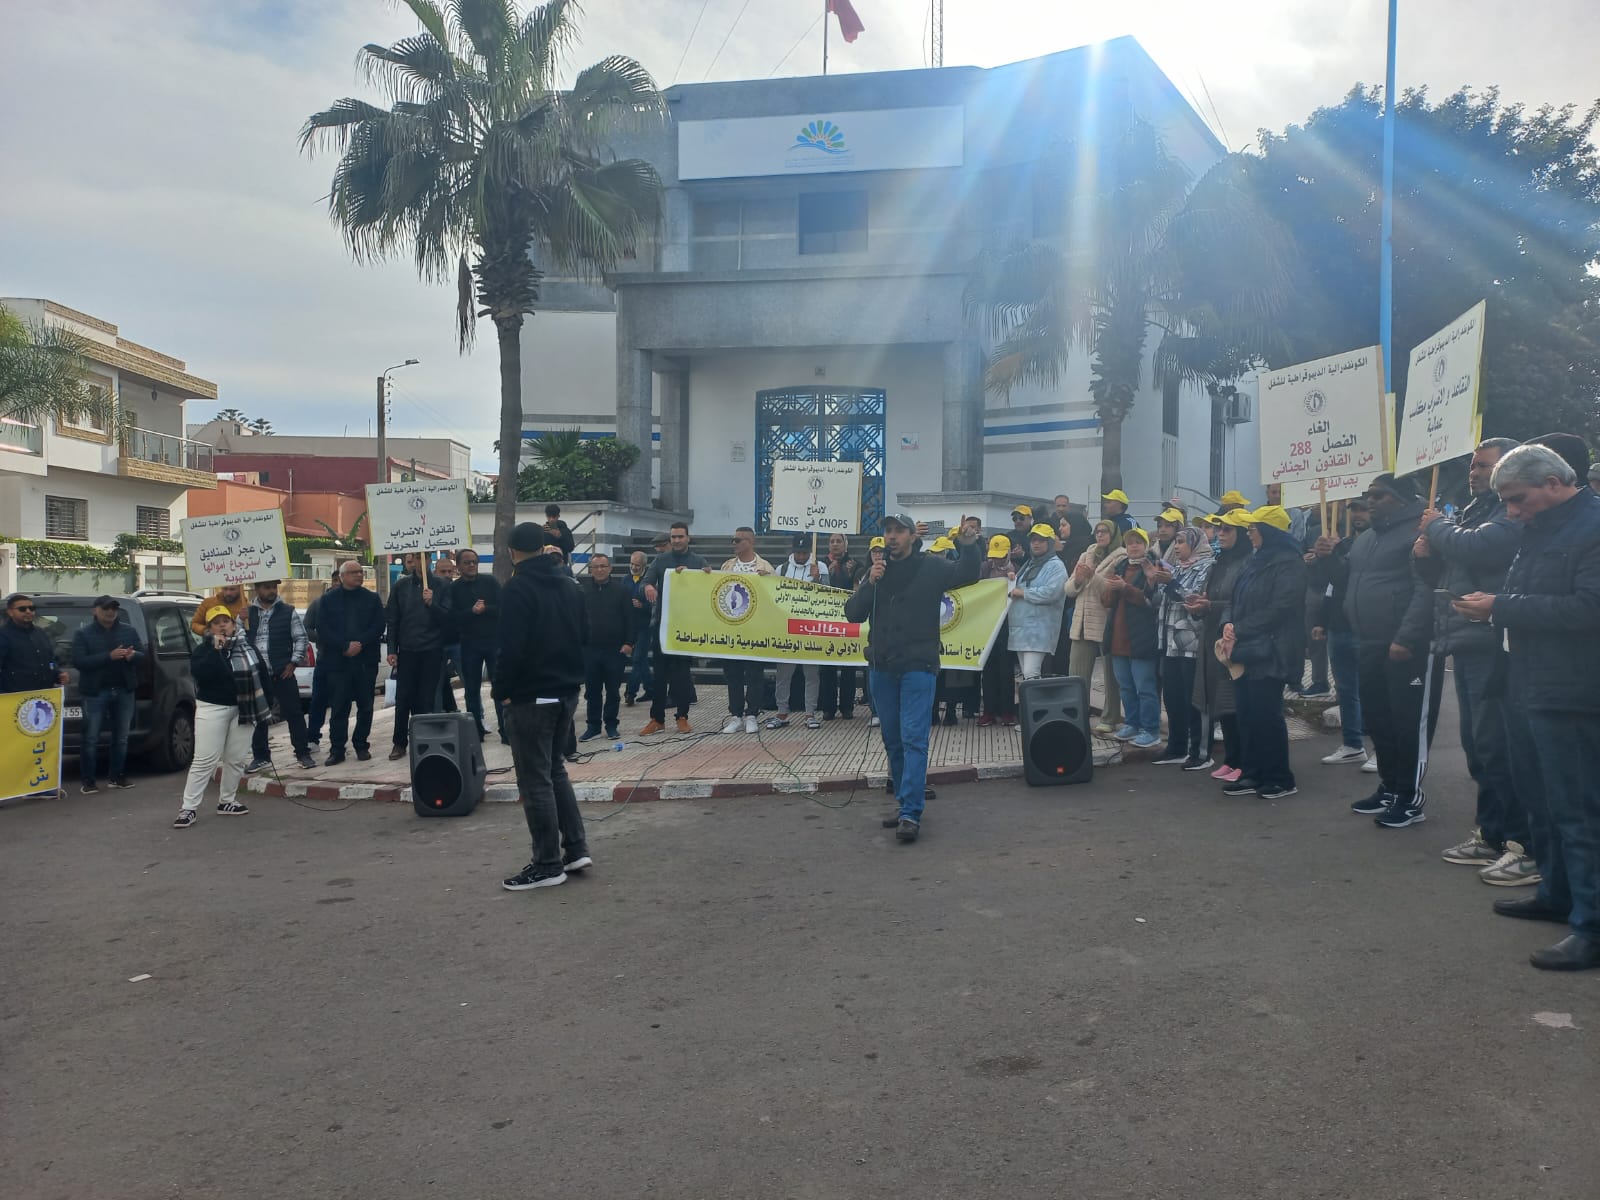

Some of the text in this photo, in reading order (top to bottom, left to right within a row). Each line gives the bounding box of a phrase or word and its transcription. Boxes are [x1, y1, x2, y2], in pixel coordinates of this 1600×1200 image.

[1328, 356, 1368, 374] الكونفدرالية
[1268, 376, 1285, 390] للشغل
[1290, 434, 1357, 456] الفصل 288
[1272, 452, 1374, 478] من القانون الجناني
[420, 514, 426, 526] لا
[778, 516, 848, 528] CNOPS في CNSS
[391, 524, 455, 539] لقانون الاضراب
[200, 542, 272, 561] حل عجز الصناديق
[384, 538, 460, 552] المكبل للحريات
[230, 557, 260, 571] استرجاع
[266, 554, 276, 568] في
[224, 571, 256, 584] المنهوبة
[776, 580, 798, 590] للشغل
[800, 624, 846, 637] يطالب:
[676, 630, 708, 646] الوساطة
[736, 634, 770, 650] العمومية
[772, 638, 802, 652] الوظيفة
[804, 640, 822, 651] سلك
[825, 641, 834, 656] في
[70, 708, 80, 716] 55
[30, 741, 48, 786] ك د ش
